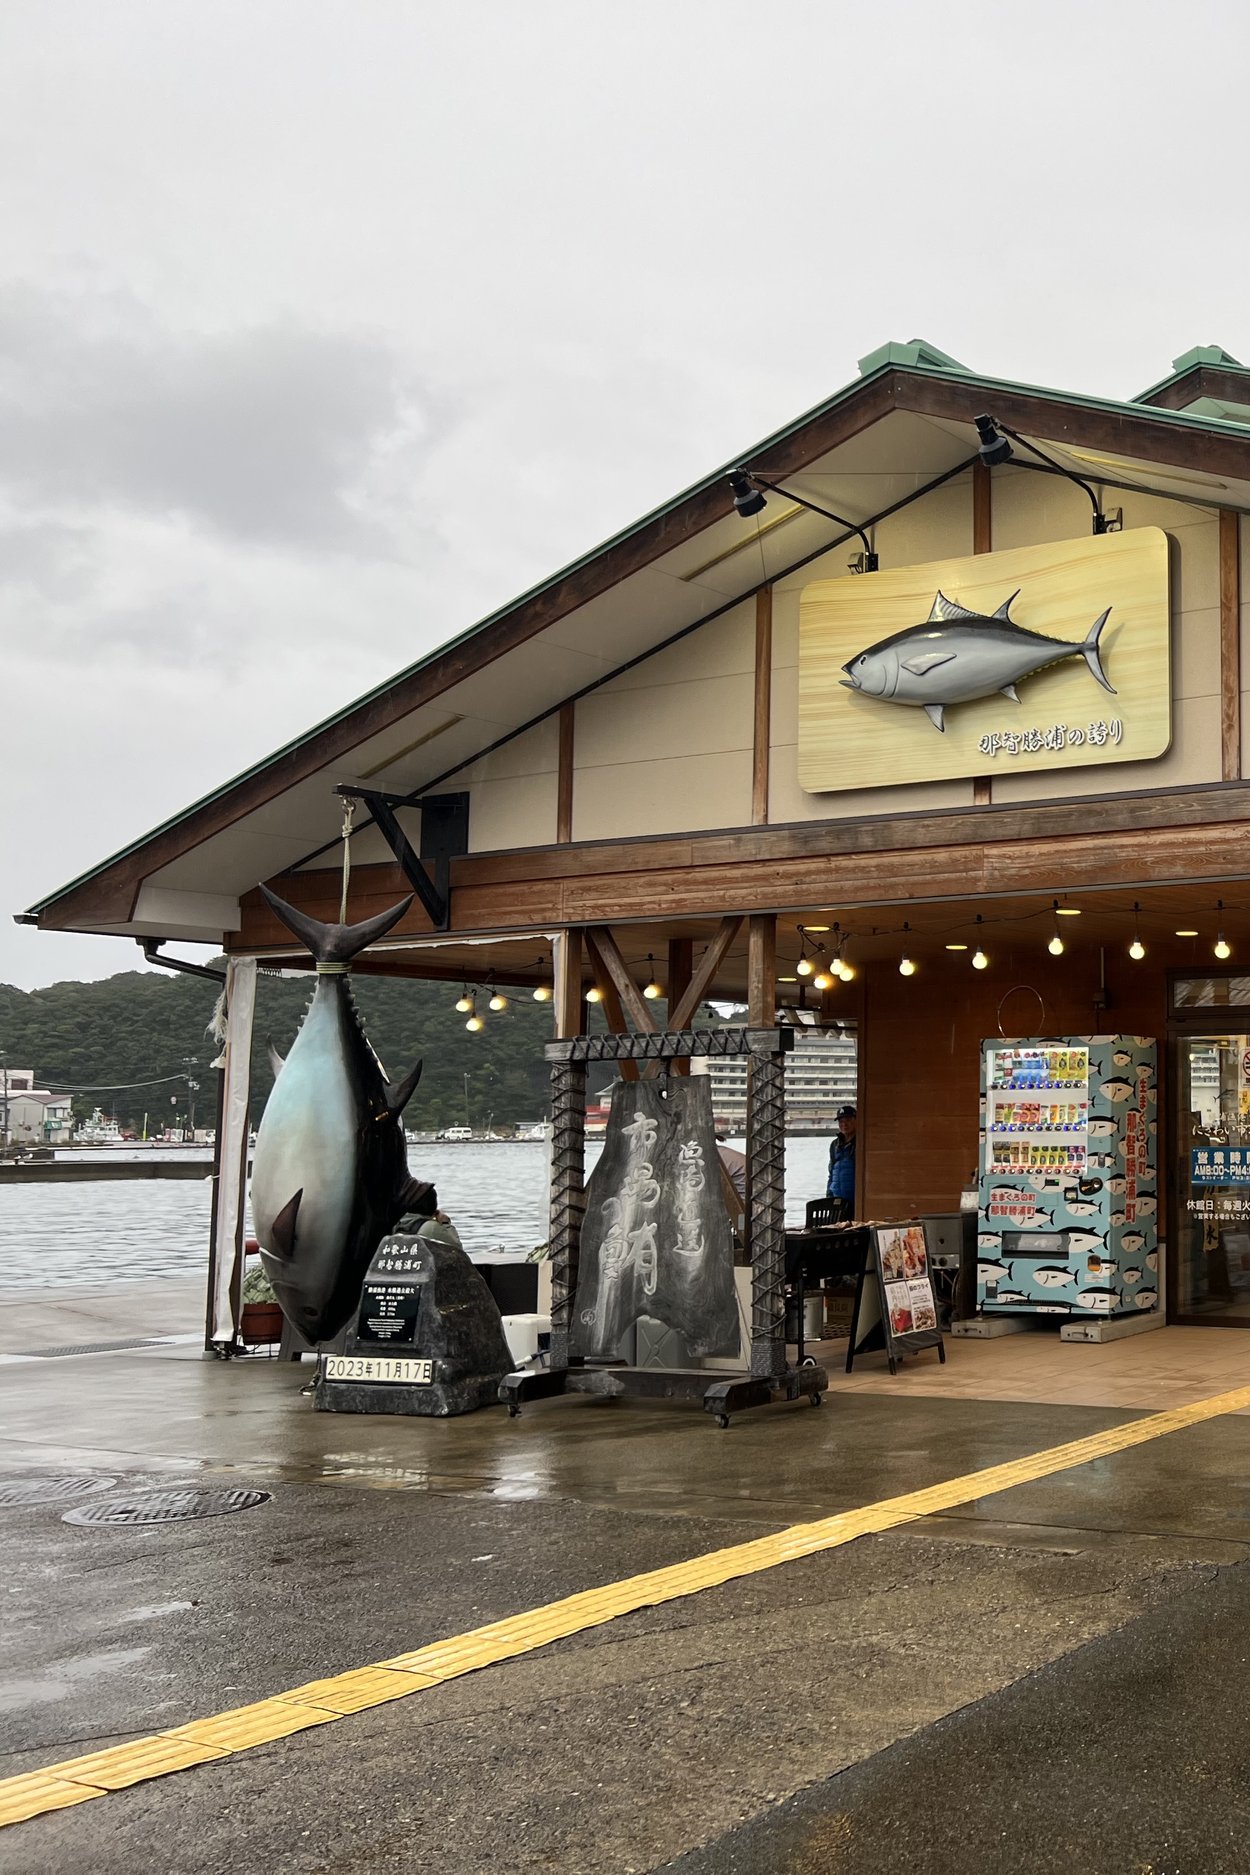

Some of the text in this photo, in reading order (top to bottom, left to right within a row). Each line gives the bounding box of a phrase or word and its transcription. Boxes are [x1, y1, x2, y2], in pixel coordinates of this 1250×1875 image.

[977, 718, 1123, 757] 那智勝浦の誇り
[990, 1192, 1036, 1202] 生まぐろの町
[990, 1205, 1036, 1216] 那智勝浦町
[382, 1243, 418, 1255] 和歌山県
[377, 1259, 422, 1271] 那智勝浦町
[327, 1360, 431, 1380] 2023年11月17日
